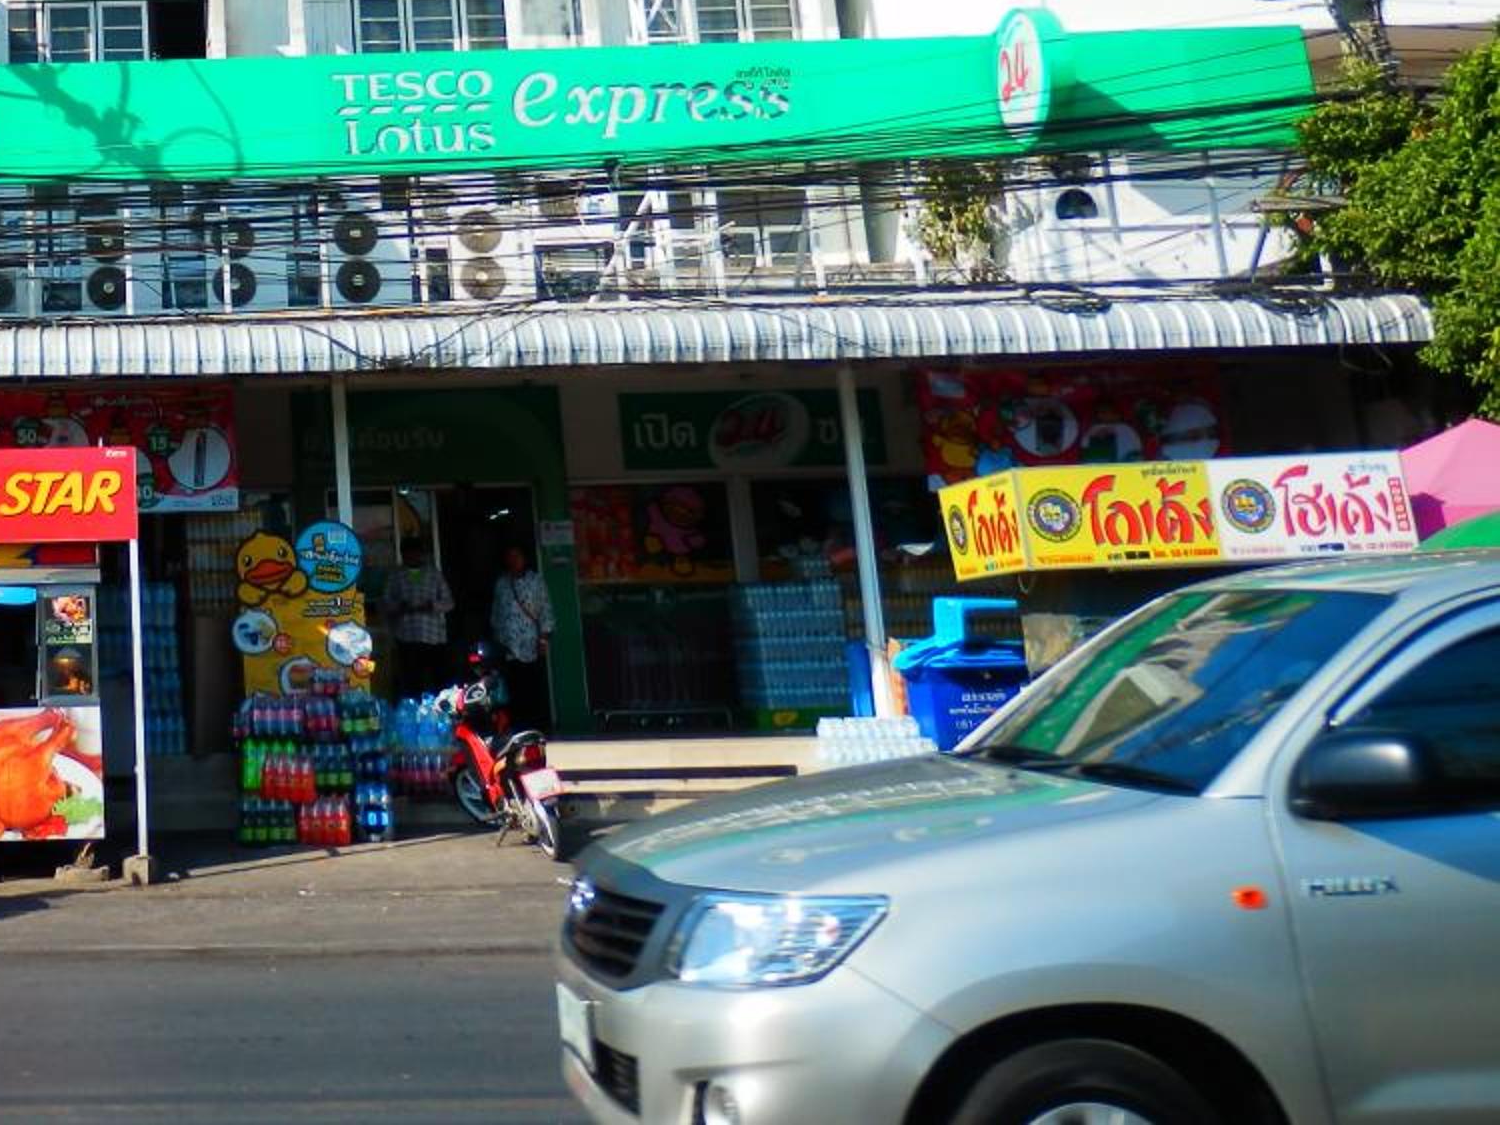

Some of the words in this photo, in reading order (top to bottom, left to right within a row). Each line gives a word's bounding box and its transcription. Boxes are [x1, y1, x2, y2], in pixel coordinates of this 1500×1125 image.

[334, 69, 493, 102] TESCO
[511, 71, 790, 139] express
[344, 117, 496, 156] Lotus
[0, 471, 122, 516] STAR
